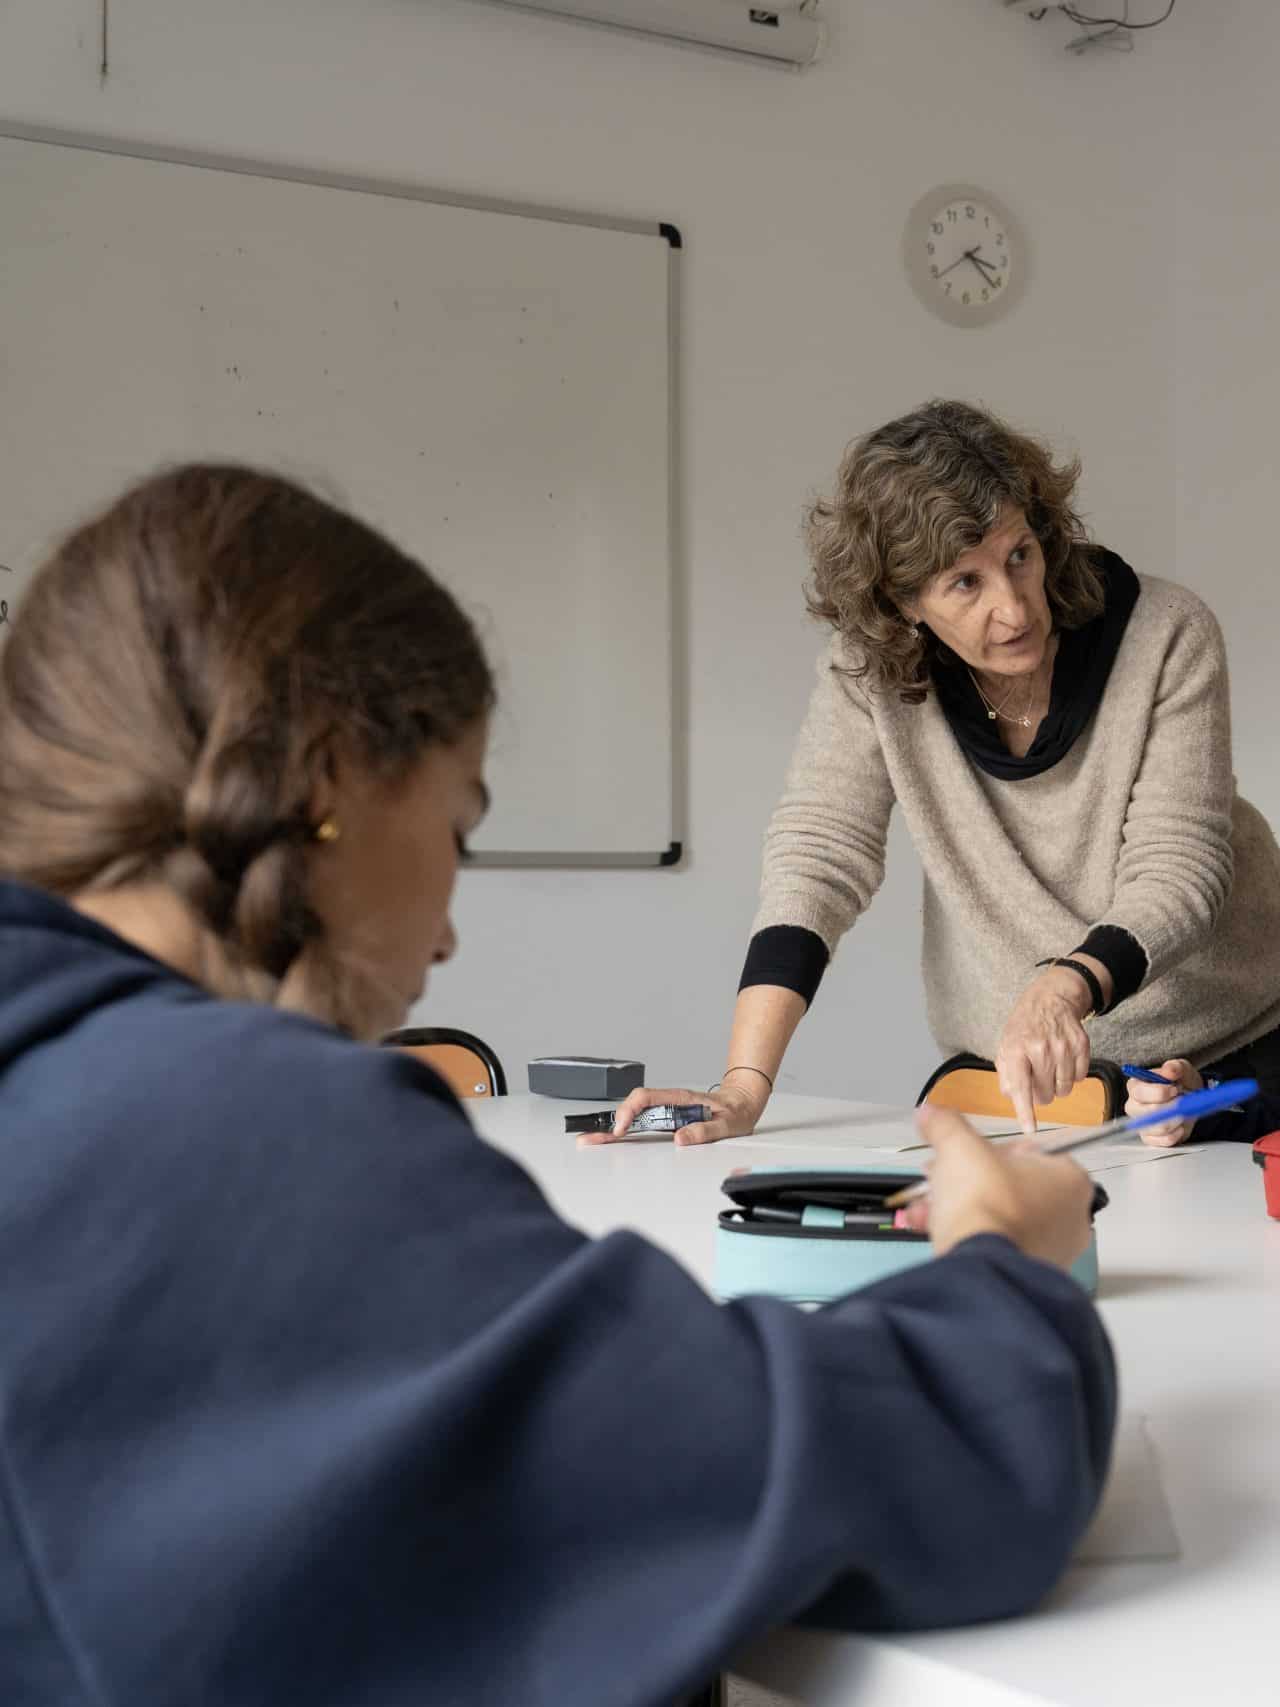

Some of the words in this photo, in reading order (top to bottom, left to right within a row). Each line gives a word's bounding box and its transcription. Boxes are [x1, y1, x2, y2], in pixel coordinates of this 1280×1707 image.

[946, 208, 957, 223] 11
[965, 205, 975, 219] 12
[931, 221, 944, 235] 10
